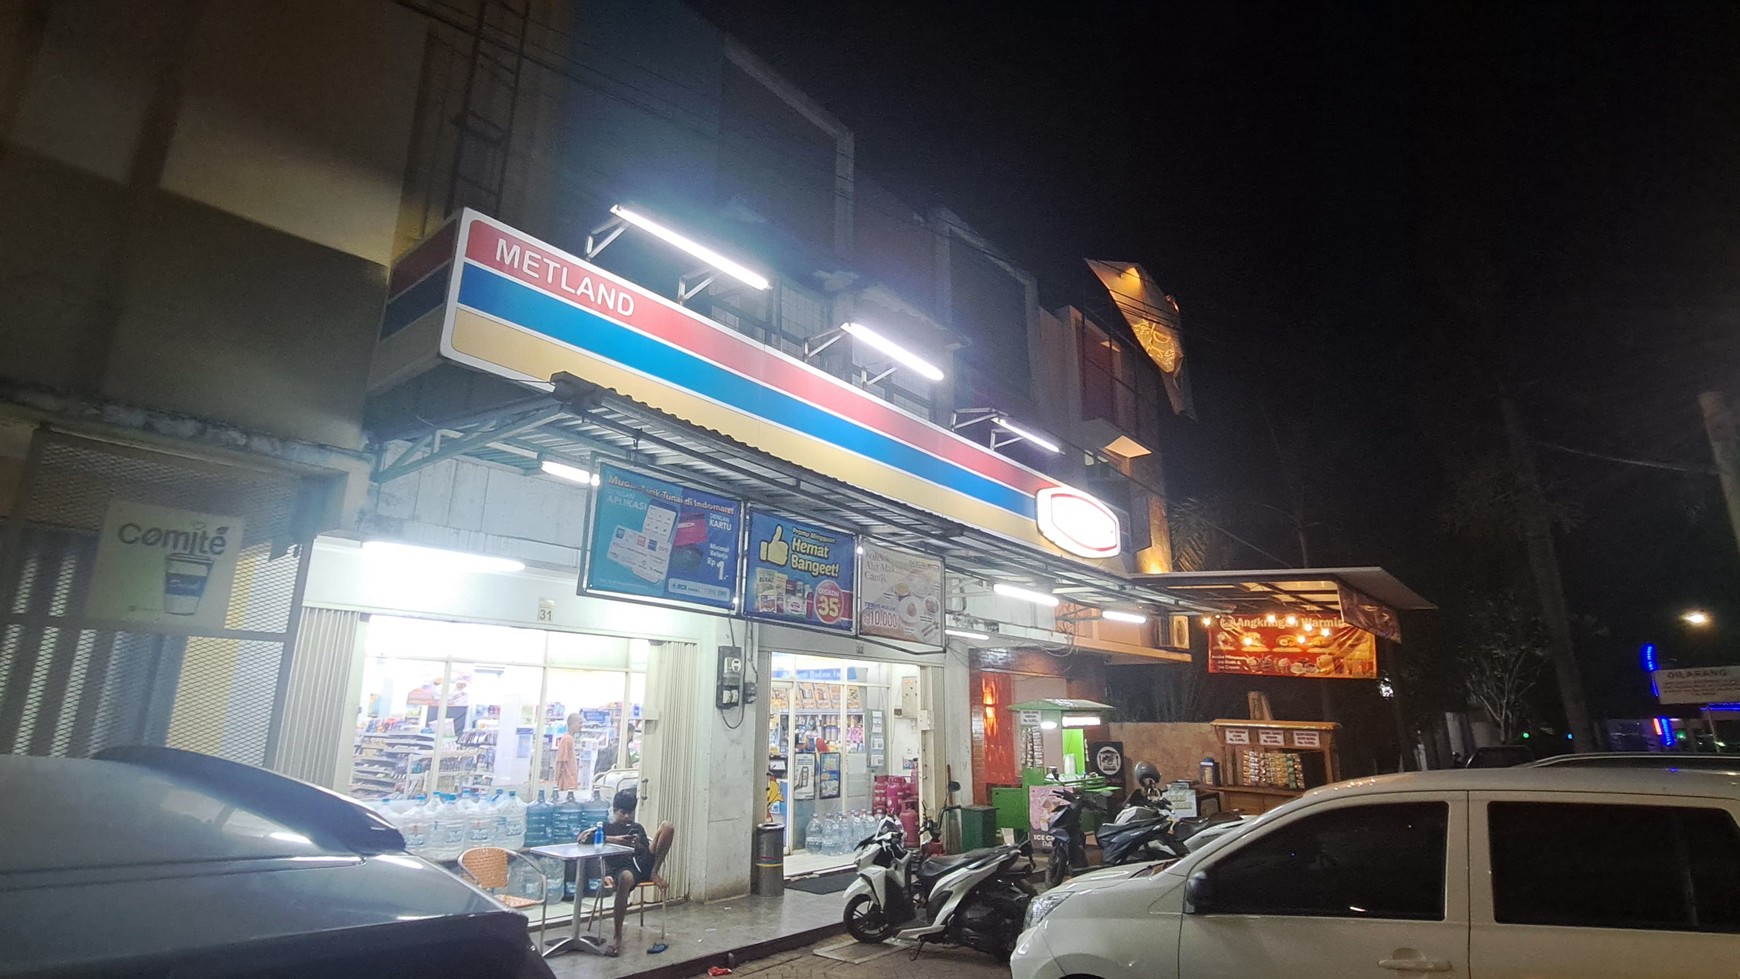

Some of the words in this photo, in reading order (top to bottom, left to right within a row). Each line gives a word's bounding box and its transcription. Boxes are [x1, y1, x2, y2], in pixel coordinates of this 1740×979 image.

[495, 238, 635, 317] METLAND
[693, 501, 735, 515] Indomaret
[709, 520, 732, 531] KARTU
[792, 527, 810, 538] Promo
[791, 538, 829, 559] Hemat
[707, 557, 716, 567] Rp
[791, 553, 840, 577] Bangeet!
[818, 595, 839, 618] 35
[540, 609, 552, 621] 31
[1238, 617, 1299, 630] Angkrngn
